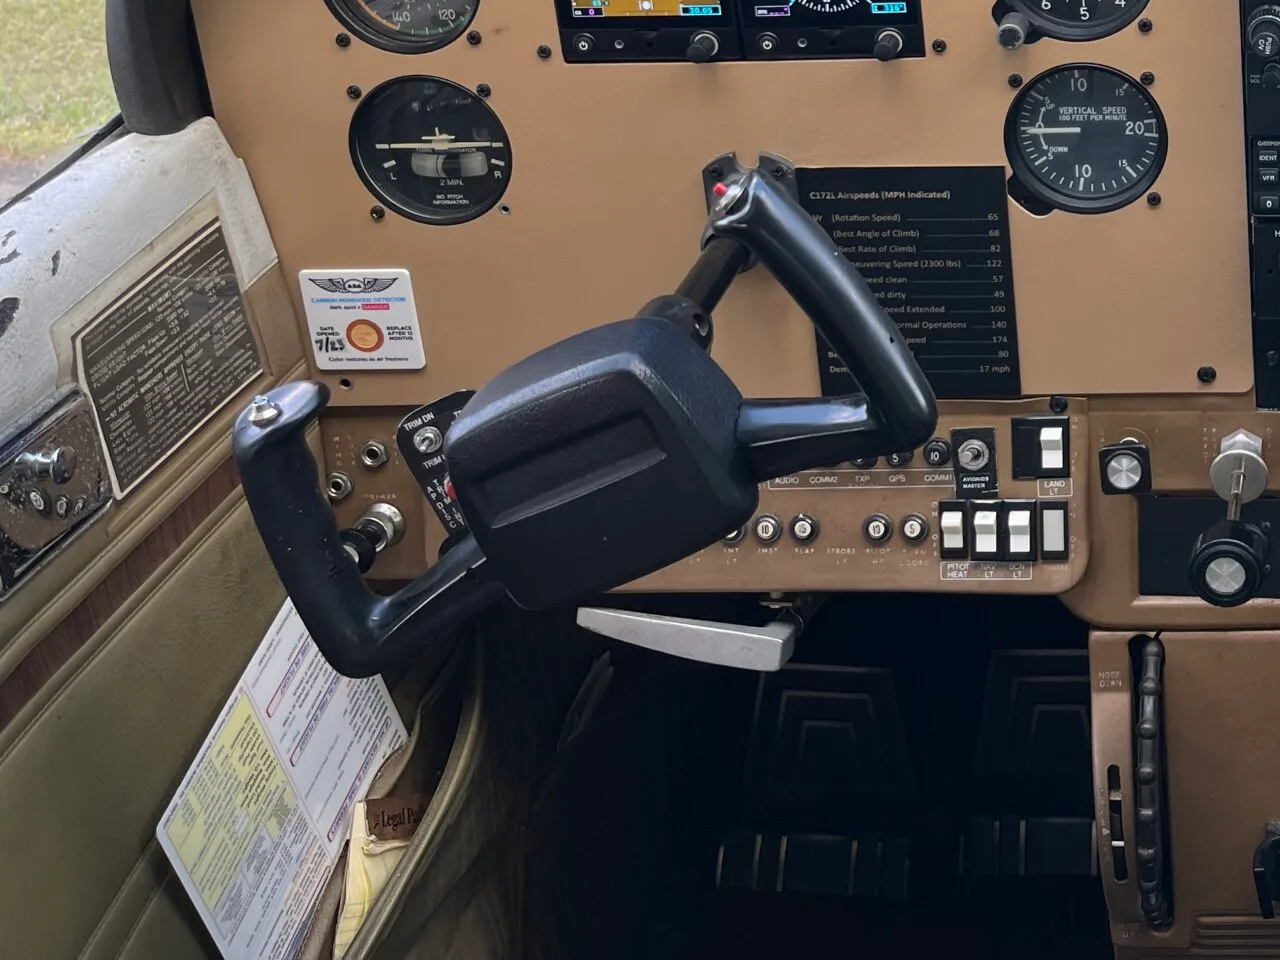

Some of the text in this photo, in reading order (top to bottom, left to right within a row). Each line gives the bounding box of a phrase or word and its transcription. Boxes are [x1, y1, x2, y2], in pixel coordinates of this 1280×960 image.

[439, 10, 455, 20] 120
[1071, 78, 1087, 91] 10
[1125, 121, 1144, 135] 20
[810, 191, 951, 200] C172L Airspeeds (MPH Indicated)
[831, 213, 999, 223] (Rotation Speed) 65
[833, 229, 1000, 238] (Best Angle of Climb) 68
[879, 245, 887, 253] of
[889, 245, 916, 254] Climb)
[893, 260, 918, 269] Speed
[920, 260, 944, 268] (2300
[946, 259, 962, 268] lbs)
[887, 291, 906, 300] dirty
[907, 305, 945, 313] Extended
[922, 321, 967, 329] Operations
[992, 366, 1010, 375] mph
[404, 412, 434, 431] TRIM DN
[924, 474, 952, 482] COMM1
[382, 807, 405, 831] Legal
